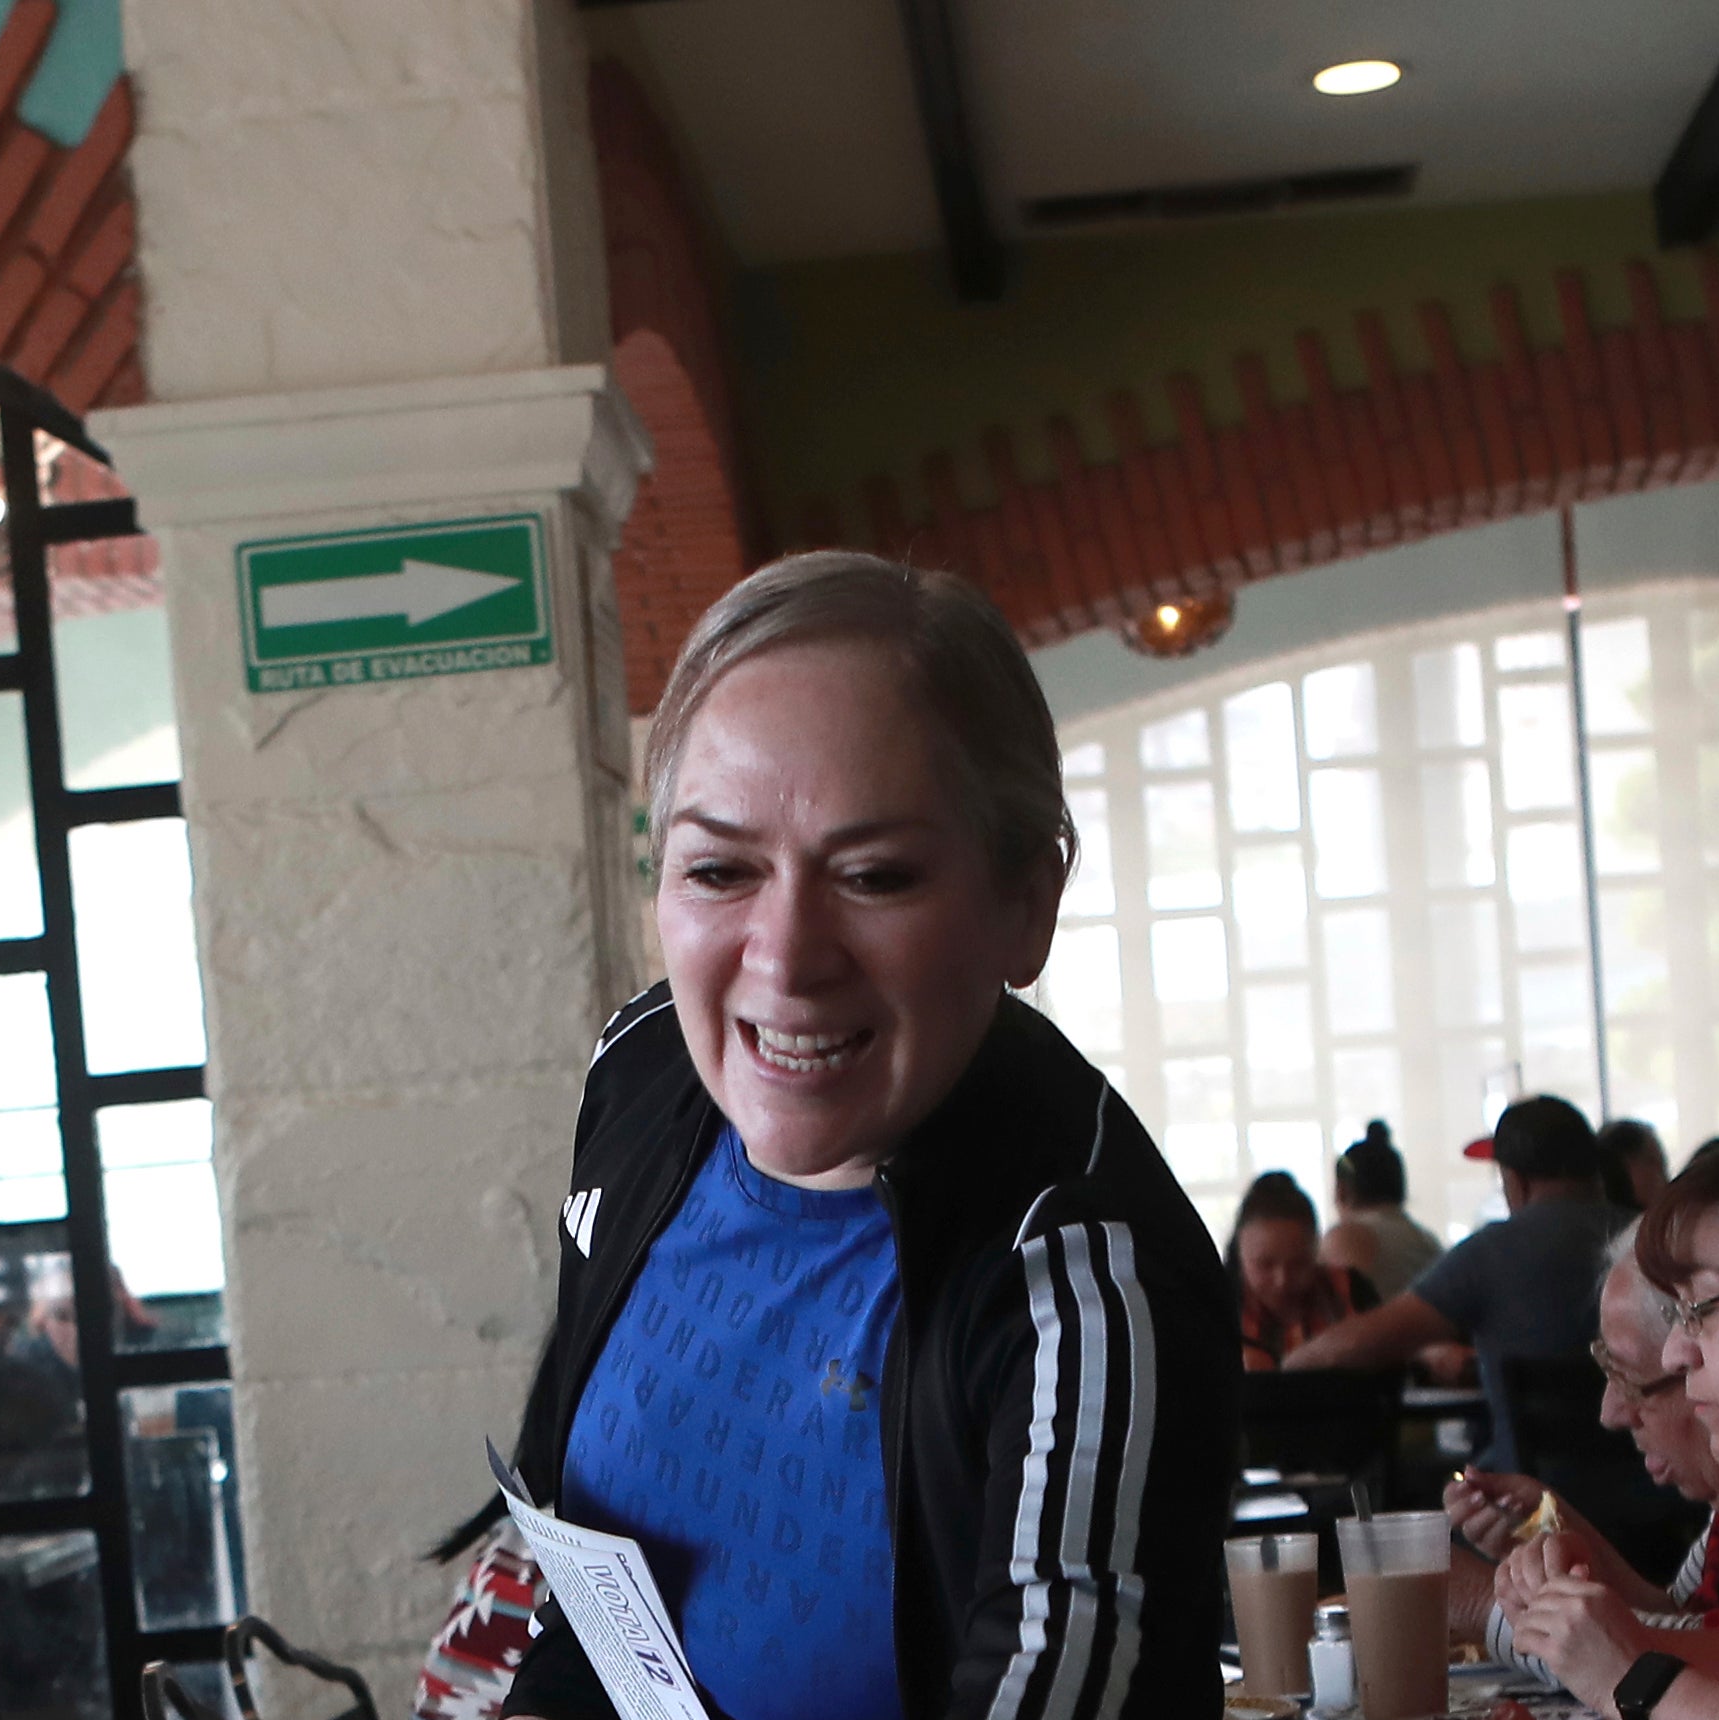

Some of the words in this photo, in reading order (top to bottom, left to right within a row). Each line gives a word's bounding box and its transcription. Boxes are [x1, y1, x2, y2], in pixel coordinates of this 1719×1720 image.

[260, 666, 325, 690] RUTA
[332, 660, 364, 682] DE
[584, 1563, 650, 1646] VOTA
[635, 1648, 678, 1691] 12
